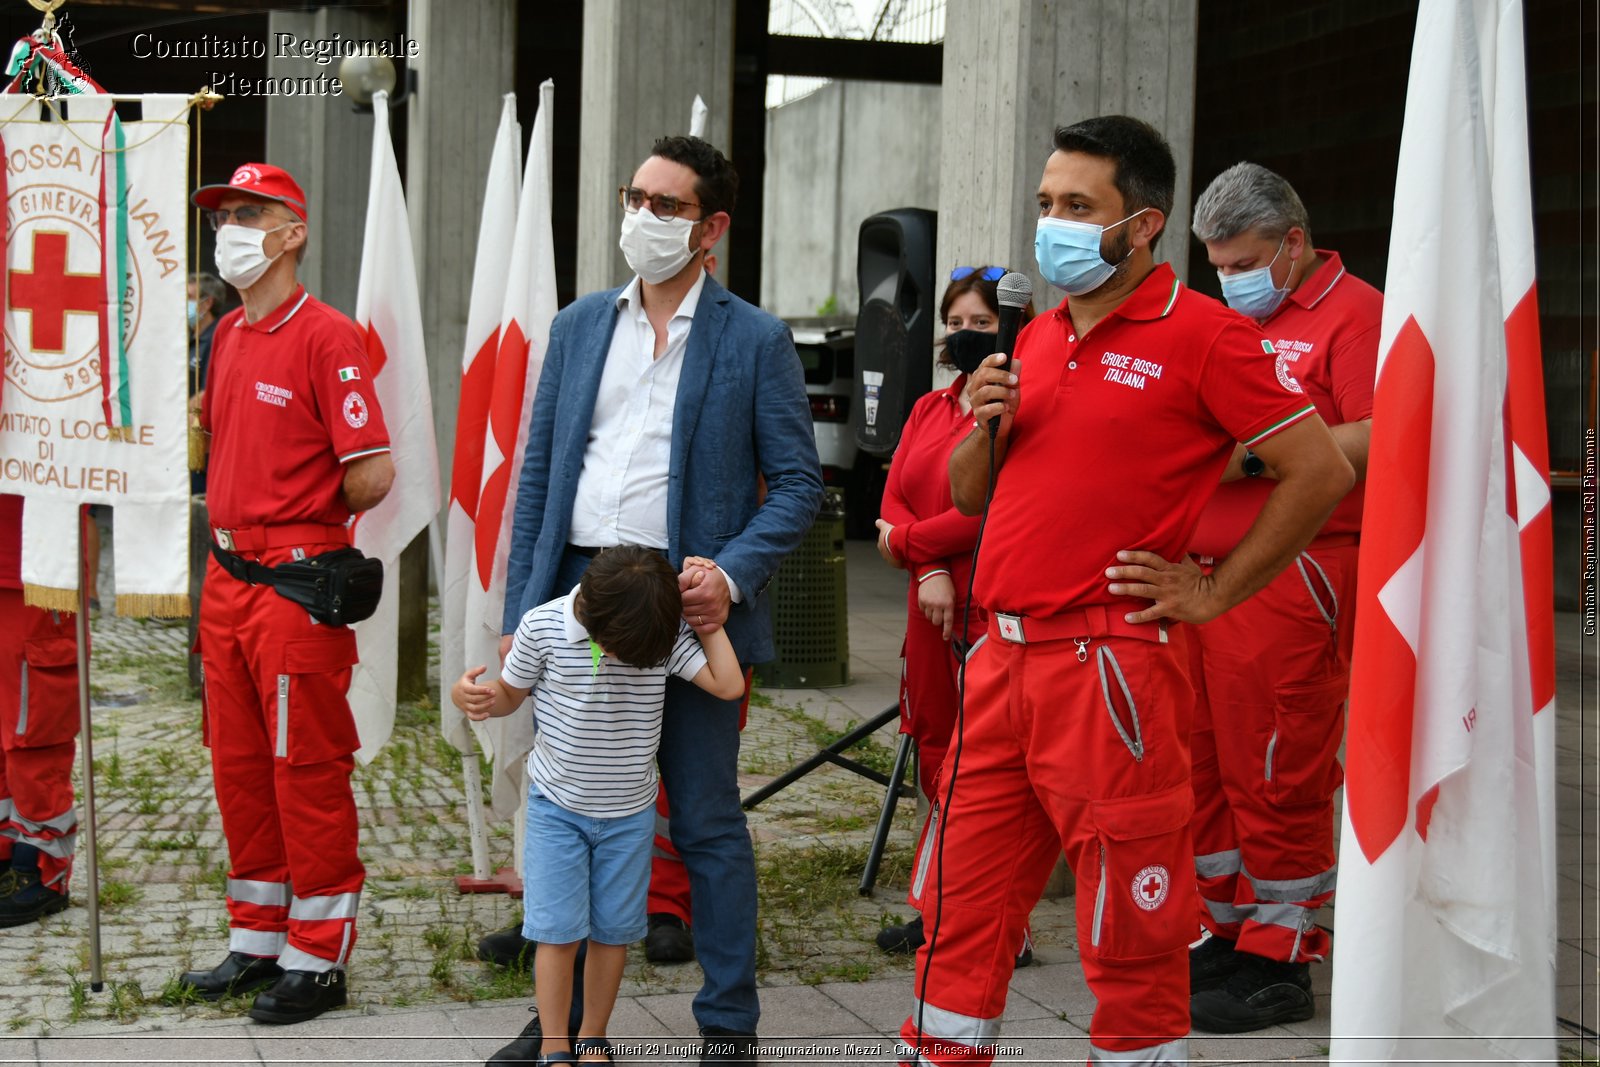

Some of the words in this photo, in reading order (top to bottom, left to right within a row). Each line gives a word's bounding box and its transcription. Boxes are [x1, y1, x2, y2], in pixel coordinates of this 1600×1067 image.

[1292, 340, 1314, 353] ROSSA
[1101, 351, 1132, 369] CROCE
[1131, 358, 1163, 380] ROSSA
[1103, 367, 1146, 390] ITALIANA
[38, 440, 54, 461] DI
[0, 457, 128, 494] ONCALIERI
